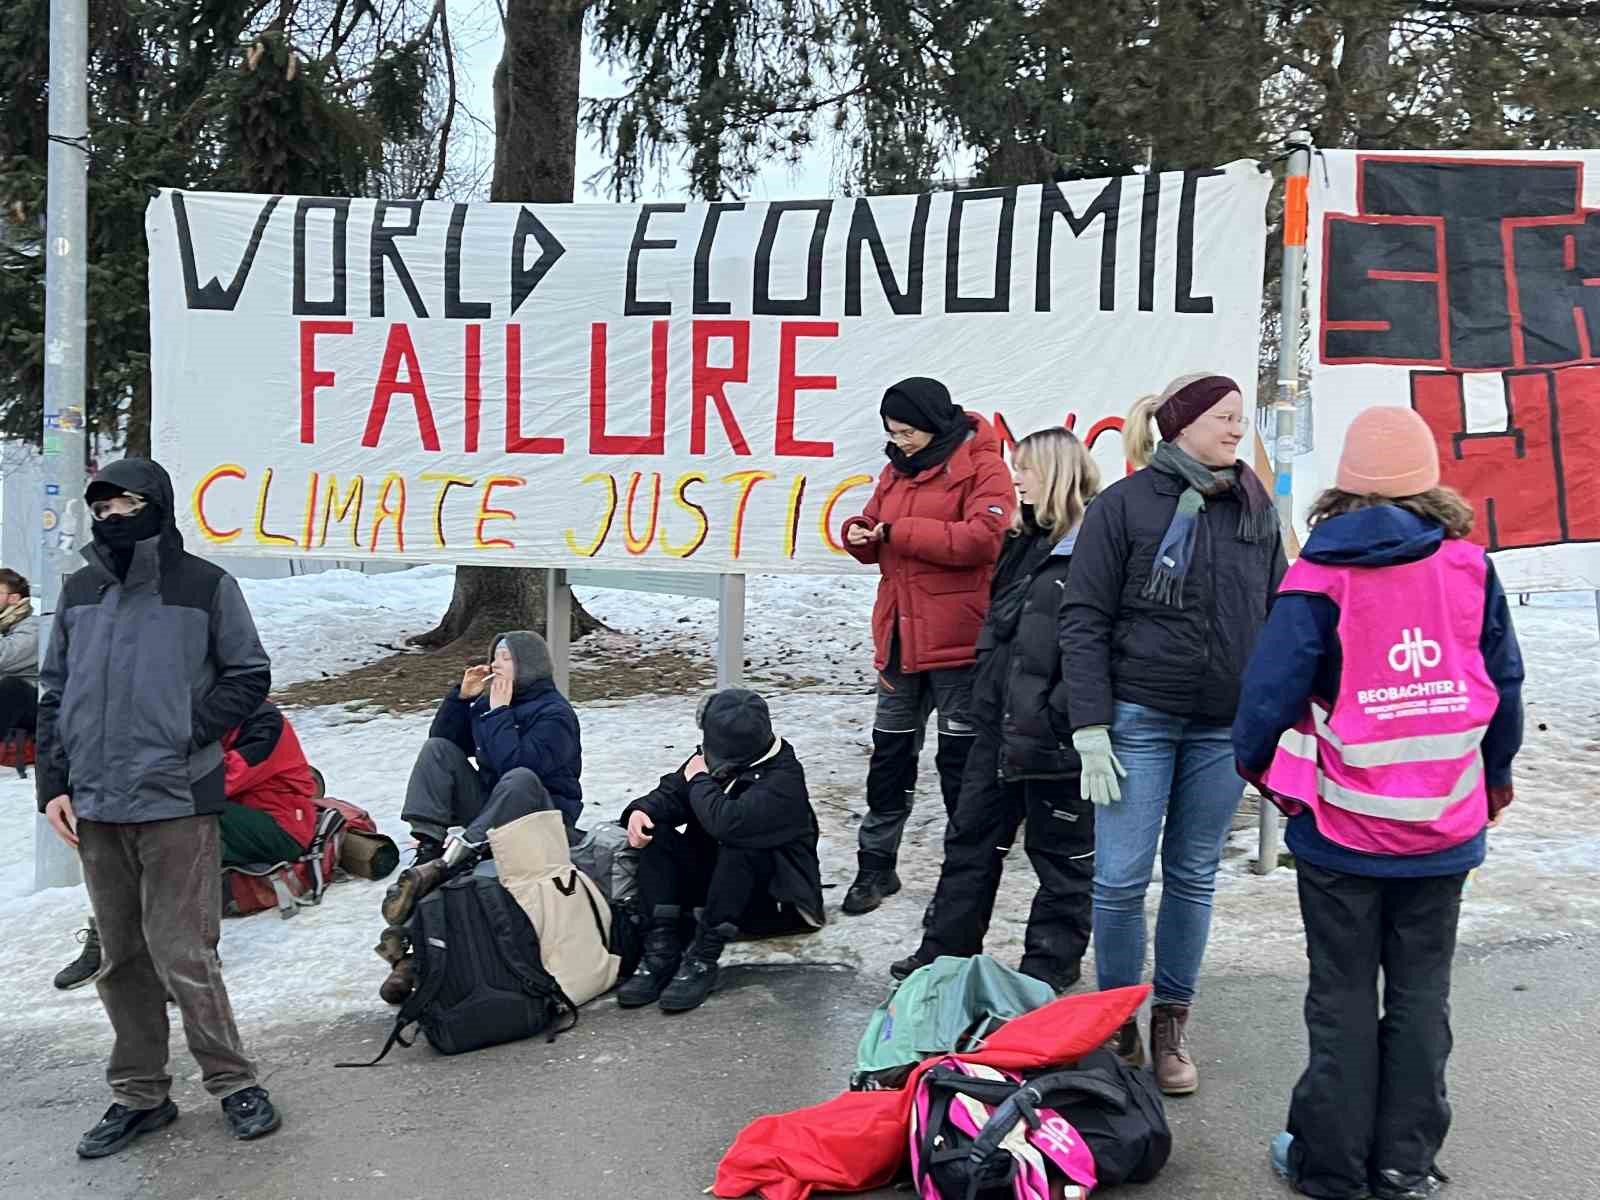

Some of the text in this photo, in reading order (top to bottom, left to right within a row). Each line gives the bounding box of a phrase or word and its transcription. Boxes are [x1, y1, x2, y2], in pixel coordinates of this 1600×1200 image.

[172, 171, 1226, 318] WORLD ECONOMIC
[300, 320, 839, 458] FAILURE
[192, 463, 874, 561] CLIMATE JUSTIC
[1357, 680, 1454, 704] BEOBACHTER
